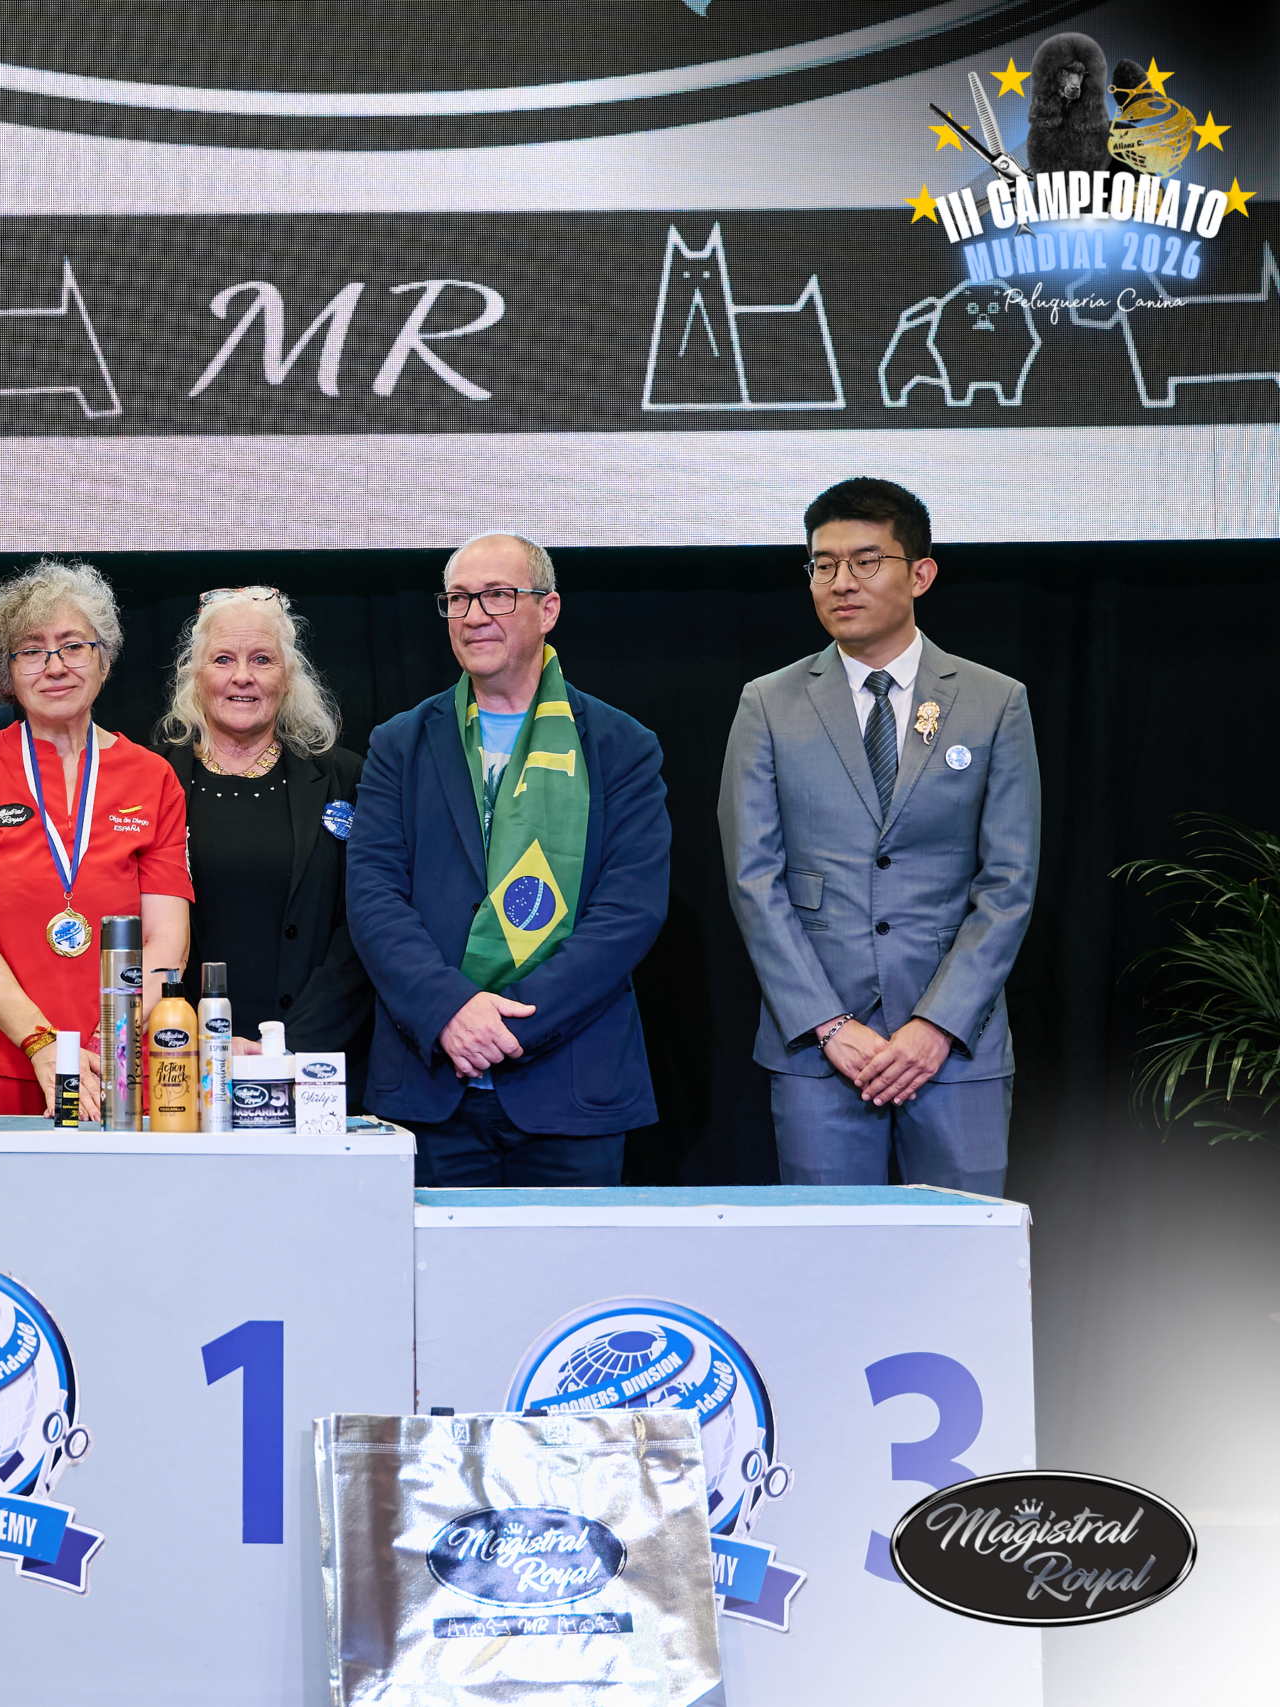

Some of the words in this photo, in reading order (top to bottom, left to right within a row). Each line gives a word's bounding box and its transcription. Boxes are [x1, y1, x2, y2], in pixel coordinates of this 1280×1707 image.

[188, 279, 505, 400] MR
[109, 815, 122, 823] Olga
[132, 818, 149, 826] Diego
[157, 1071, 190, 1084] Mask
[158, 1062, 186, 1074] Action
[270, 1085, 285, 1106] 5
[621, 1351, 683, 1397] DIVISION
[201, 1320, 284, 1545] 1
[864, 1351, 984, 1584] 3
[447, 1525, 590, 1568] Magistral
[513, 1556, 602, 1597] Royal
[518, 1616, 550, 1634] MR
